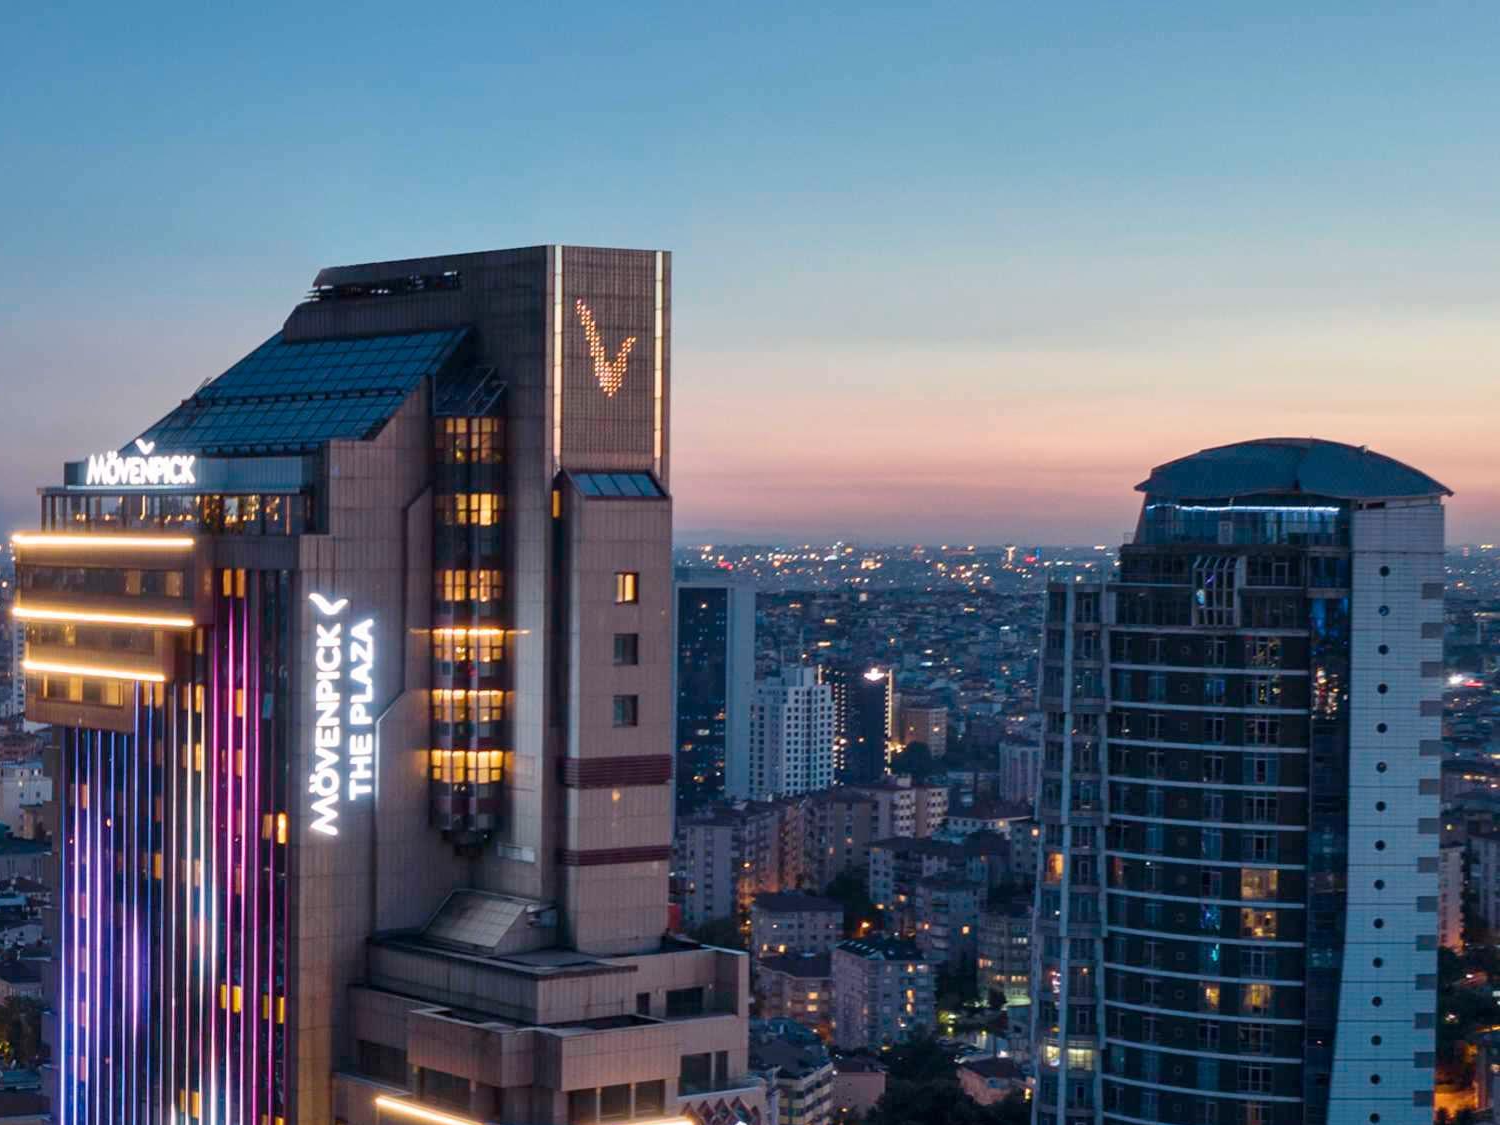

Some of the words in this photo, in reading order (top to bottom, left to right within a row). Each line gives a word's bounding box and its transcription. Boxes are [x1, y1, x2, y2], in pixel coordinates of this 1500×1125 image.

[86, 450, 196, 485] MÖVENPICK
[350, 618, 374, 725] PLAZA
[309, 623, 341, 836] MÖVENPICK
[349, 733, 373, 801] THE
